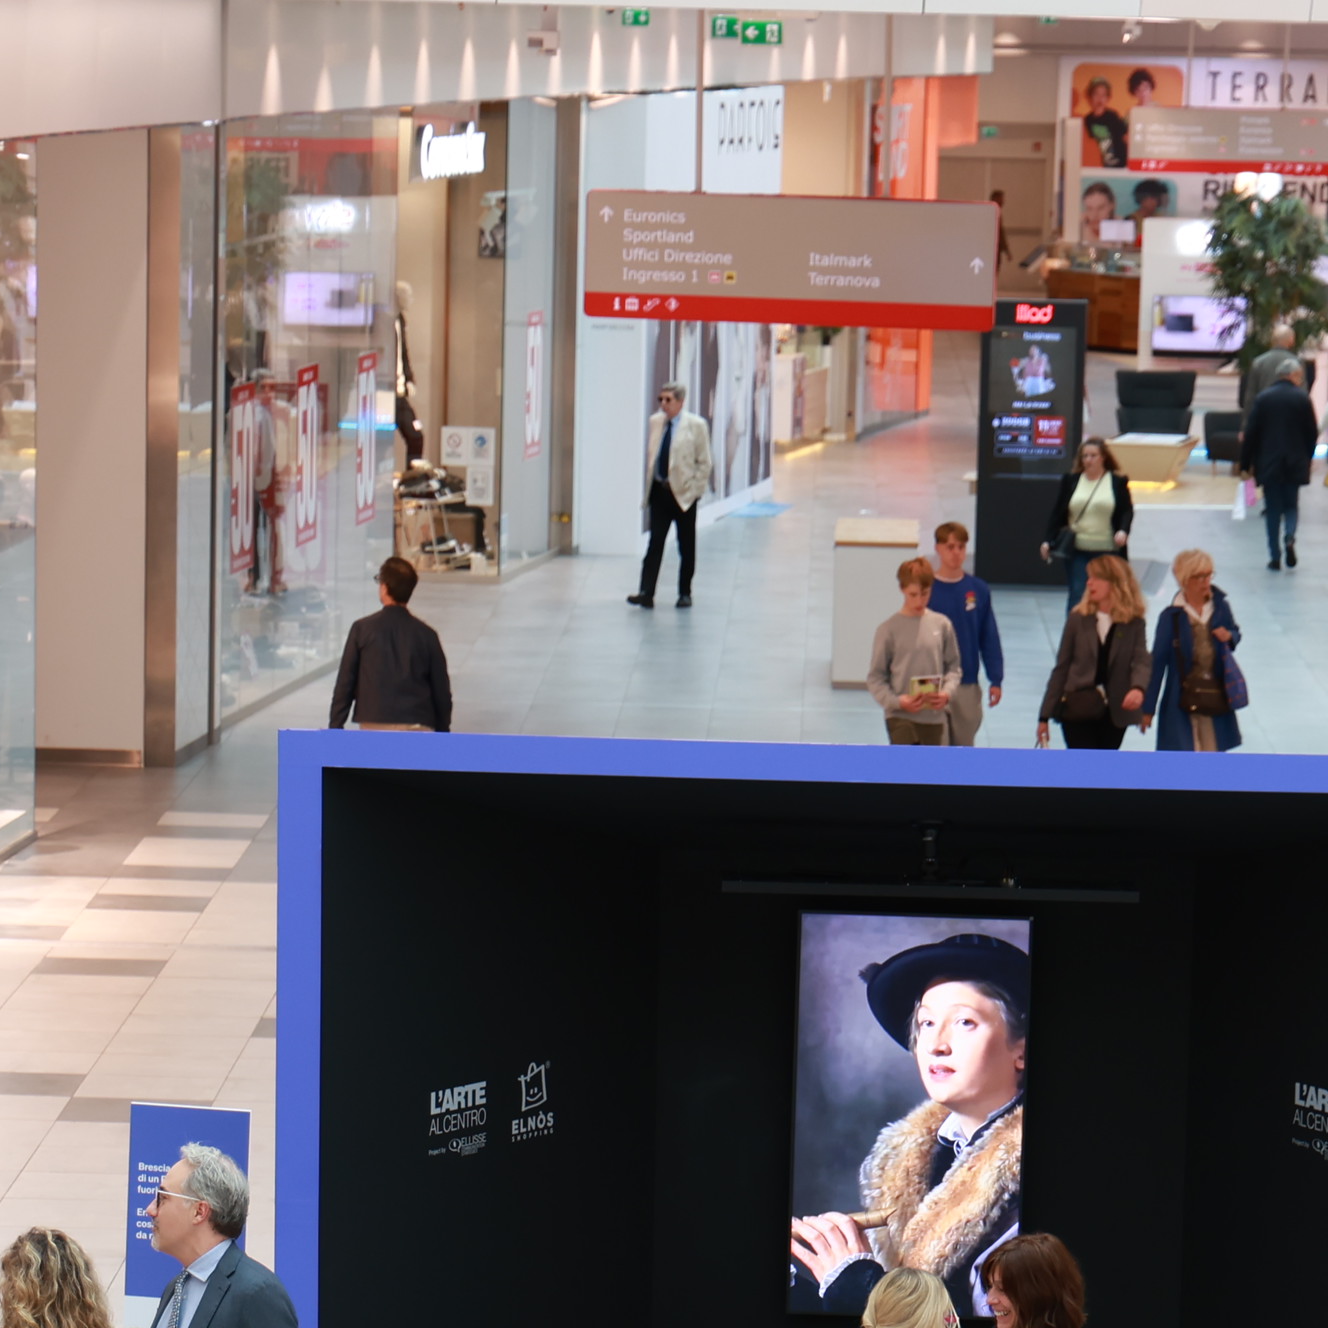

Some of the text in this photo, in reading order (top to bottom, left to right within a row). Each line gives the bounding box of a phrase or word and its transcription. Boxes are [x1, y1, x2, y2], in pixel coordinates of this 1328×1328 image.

[623, 208, 685, 224] Euronics
[623, 228, 694, 244] Sportland
[622, 248, 733, 265] Uffici Direzione
[808, 252, 873, 268] Italmark
[622, 267, 699, 284] Ingresso 1
[808, 272, 881, 288] Terranova
[430, 1081, 487, 1115] L'ARTE
[512, 1111, 554, 1134] ELNÒS
[512, 1128, 554, 1143] SHOPPING
[137, 1174, 146, 1183] di
[148, 1175, 159, 1183] un
[136, 1231, 147, 1239] da
